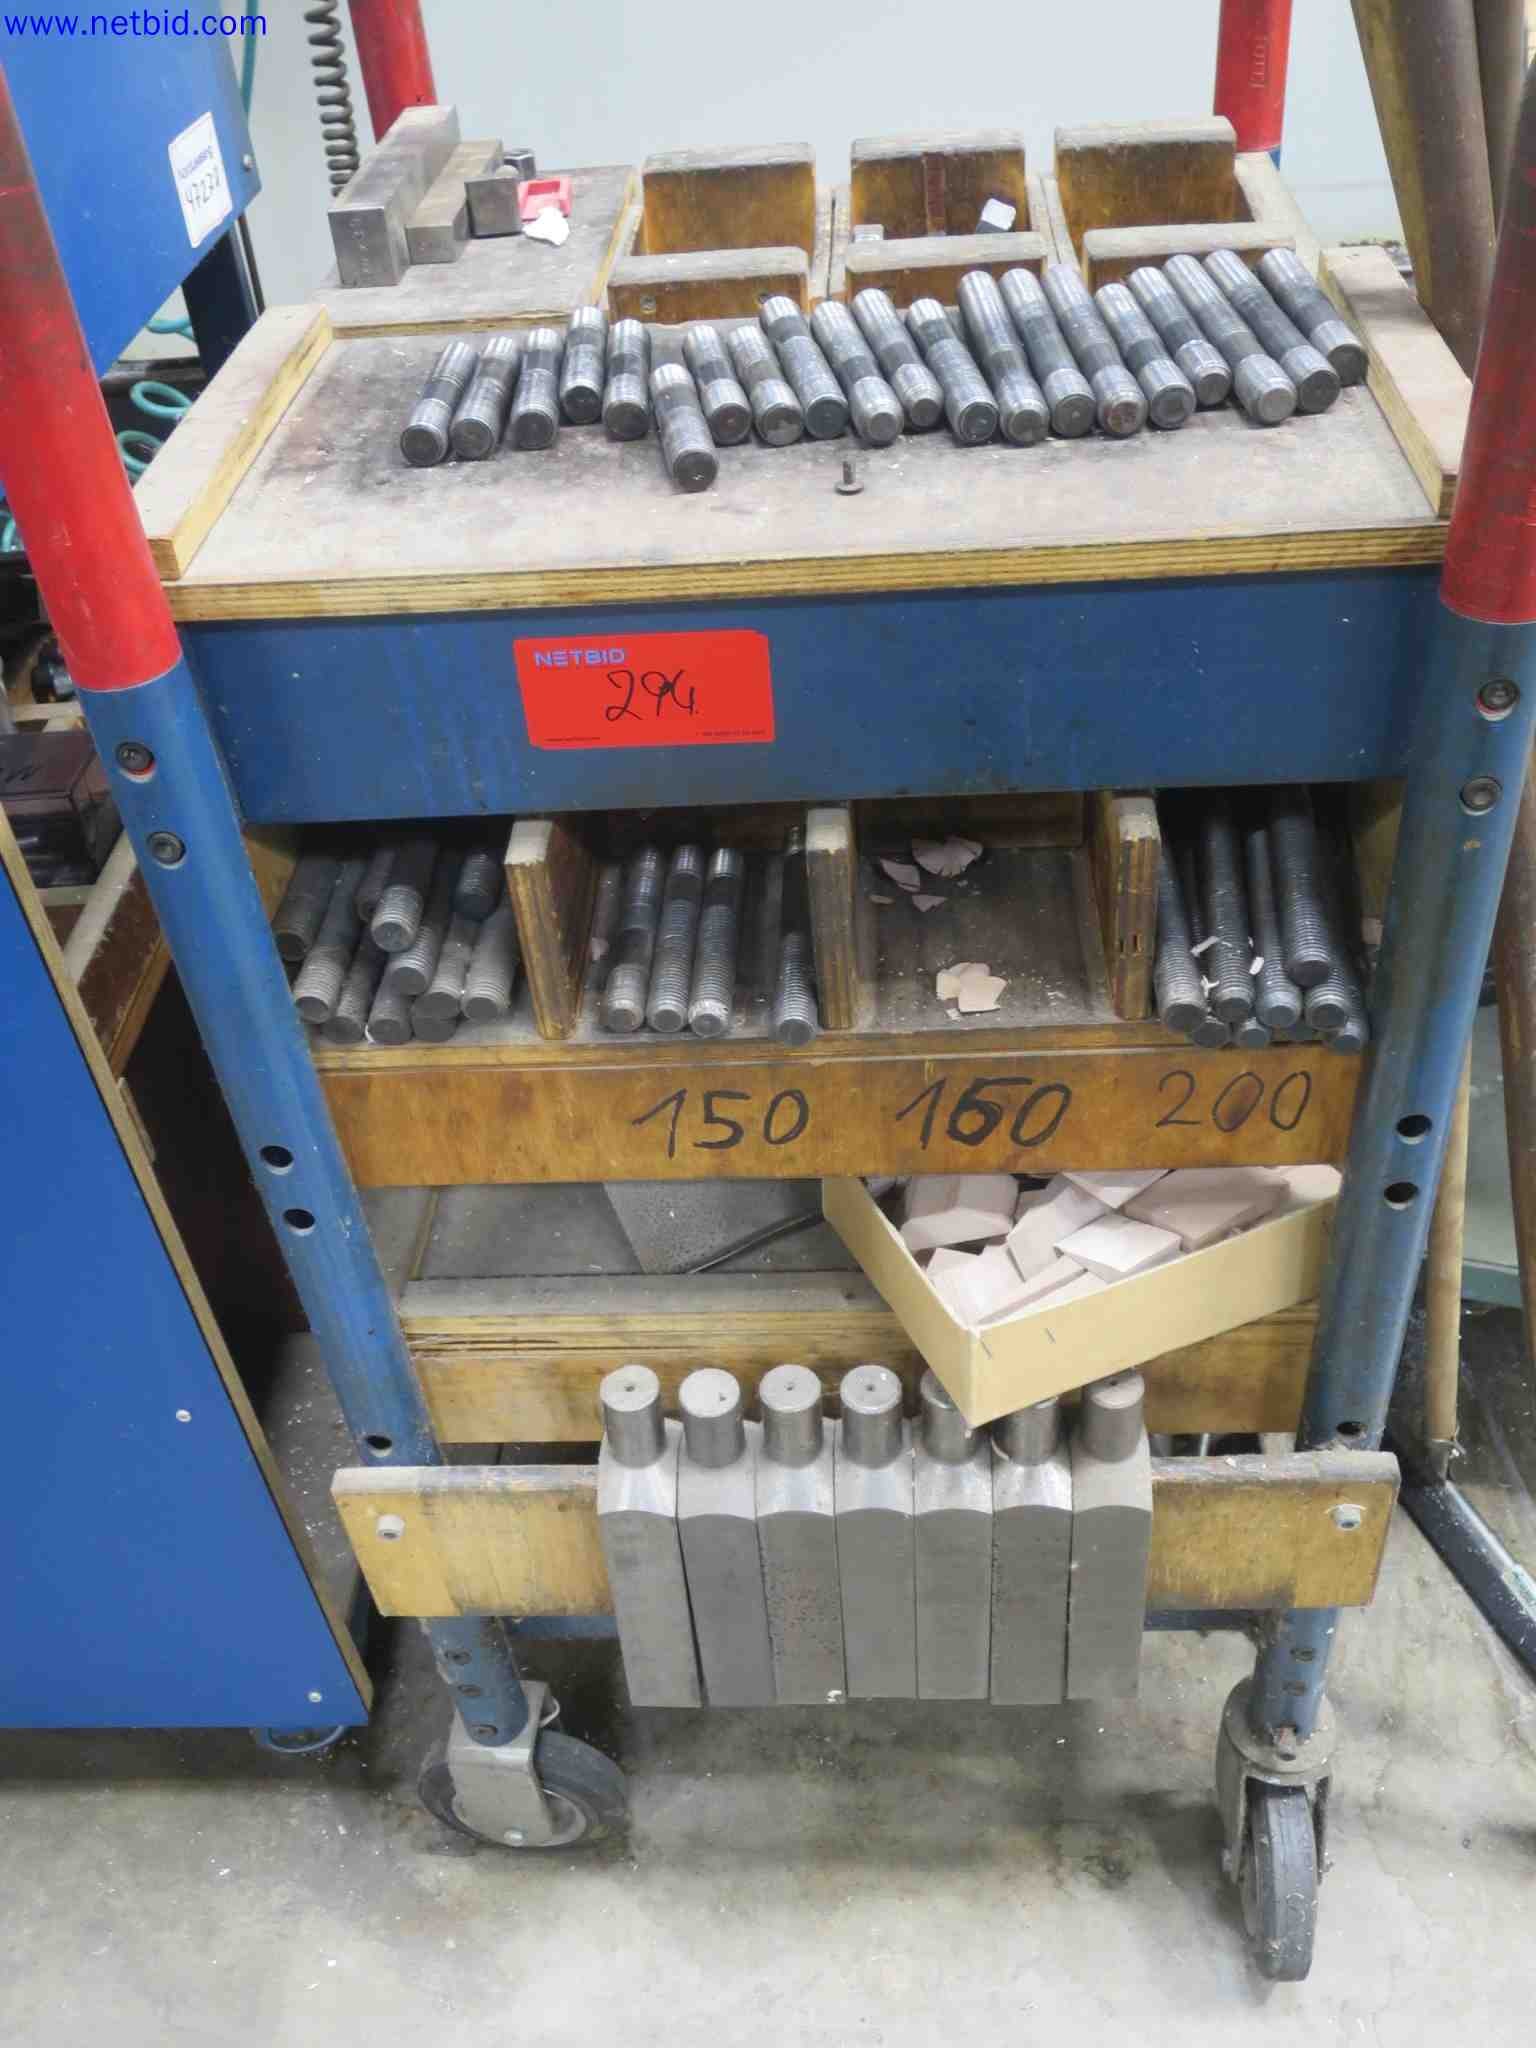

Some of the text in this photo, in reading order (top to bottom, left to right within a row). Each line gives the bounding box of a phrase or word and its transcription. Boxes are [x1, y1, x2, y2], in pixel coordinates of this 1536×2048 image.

[533, 648, 626, 668] NETBID
[632, 1088, 811, 1159] 150
[1154, 1069, 1312, 1133] 200
